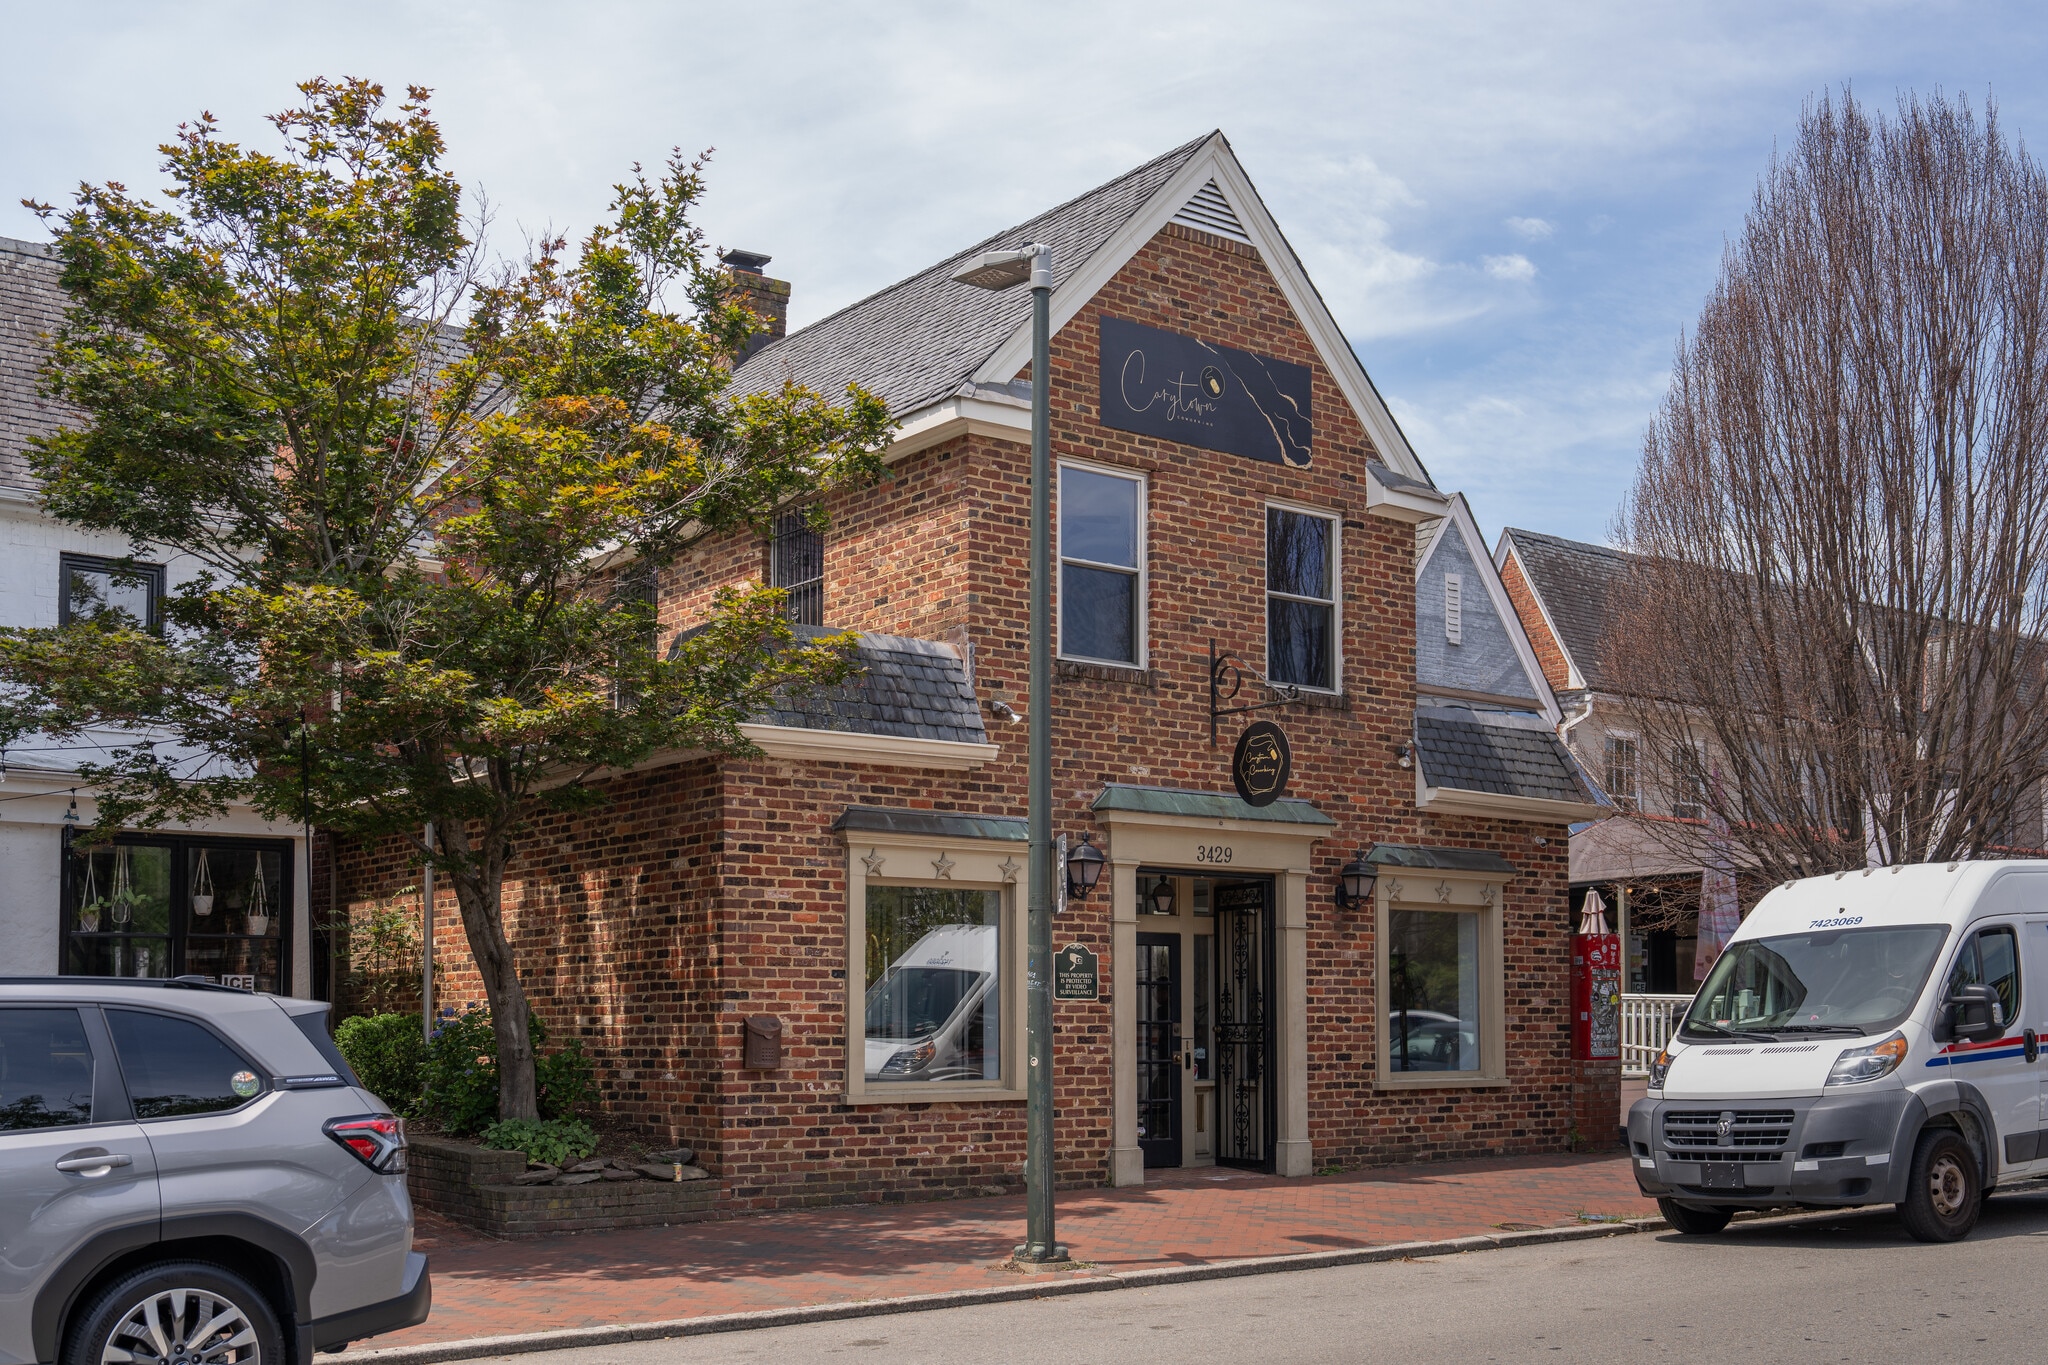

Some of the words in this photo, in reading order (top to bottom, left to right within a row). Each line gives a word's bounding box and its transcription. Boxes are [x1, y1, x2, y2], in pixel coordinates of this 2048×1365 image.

[1121, 349, 1217, 421] Carytown
[1196, 845, 1233, 864] 3429
[1808, 916, 1863, 929] 7423069
[86, 1304, 121, 1365] DGESTONE
